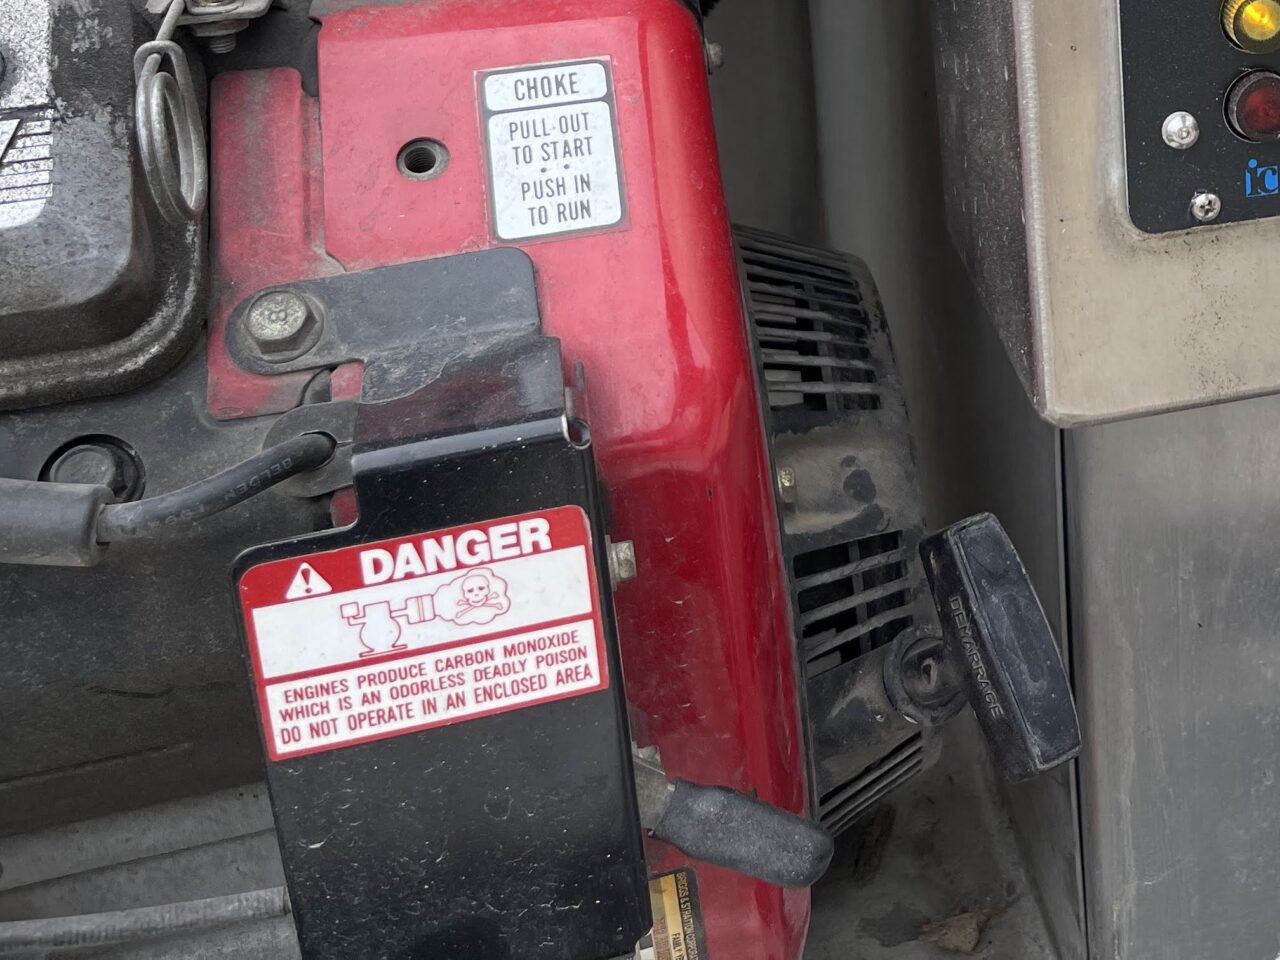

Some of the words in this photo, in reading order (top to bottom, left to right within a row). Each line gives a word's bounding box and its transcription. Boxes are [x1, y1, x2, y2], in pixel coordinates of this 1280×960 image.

[514, 72, 580, 101] CHOKE
[509, 116, 550, 141] PULL
[559, 112, 590, 134] OUT
[512, 145, 532, 165] TO
[540, 136, 593, 162] START
[521, 176, 566, 201] PUSH
[574, 173, 592, 194] IN
[528, 205, 548, 227] TO
[557, 199, 592, 223] RUN
[224, 457, 293, 501] BELDEN
[360, 517, 552, 584] DANGER
[284, 678, 349, 704] ENGINES
[357, 662, 427, 689] PRODUCE
[435, 649, 494, 673] CARBON
[503, 630, 580, 658] MONOXIDE
[279, 699, 330, 722] WHICH
[338, 694, 353, 711] IS
[361, 689, 381, 707] AN
[390, 672, 465, 700] ODORLESS
[474, 659, 527, 682] DEADLY
[535, 645, 588, 668] POISON
[280, 726, 301, 745] DO
[309, 718, 339, 738] NOT
[347, 701, 416, 731] OPERATE
[421, 697, 438, 714] IN
[446, 692, 466, 710] AN
[474, 676, 548, 704] ENCLOSED
[555, 665, 593, 690] AREA
[676, 872, 689, 898] BRIGGS
